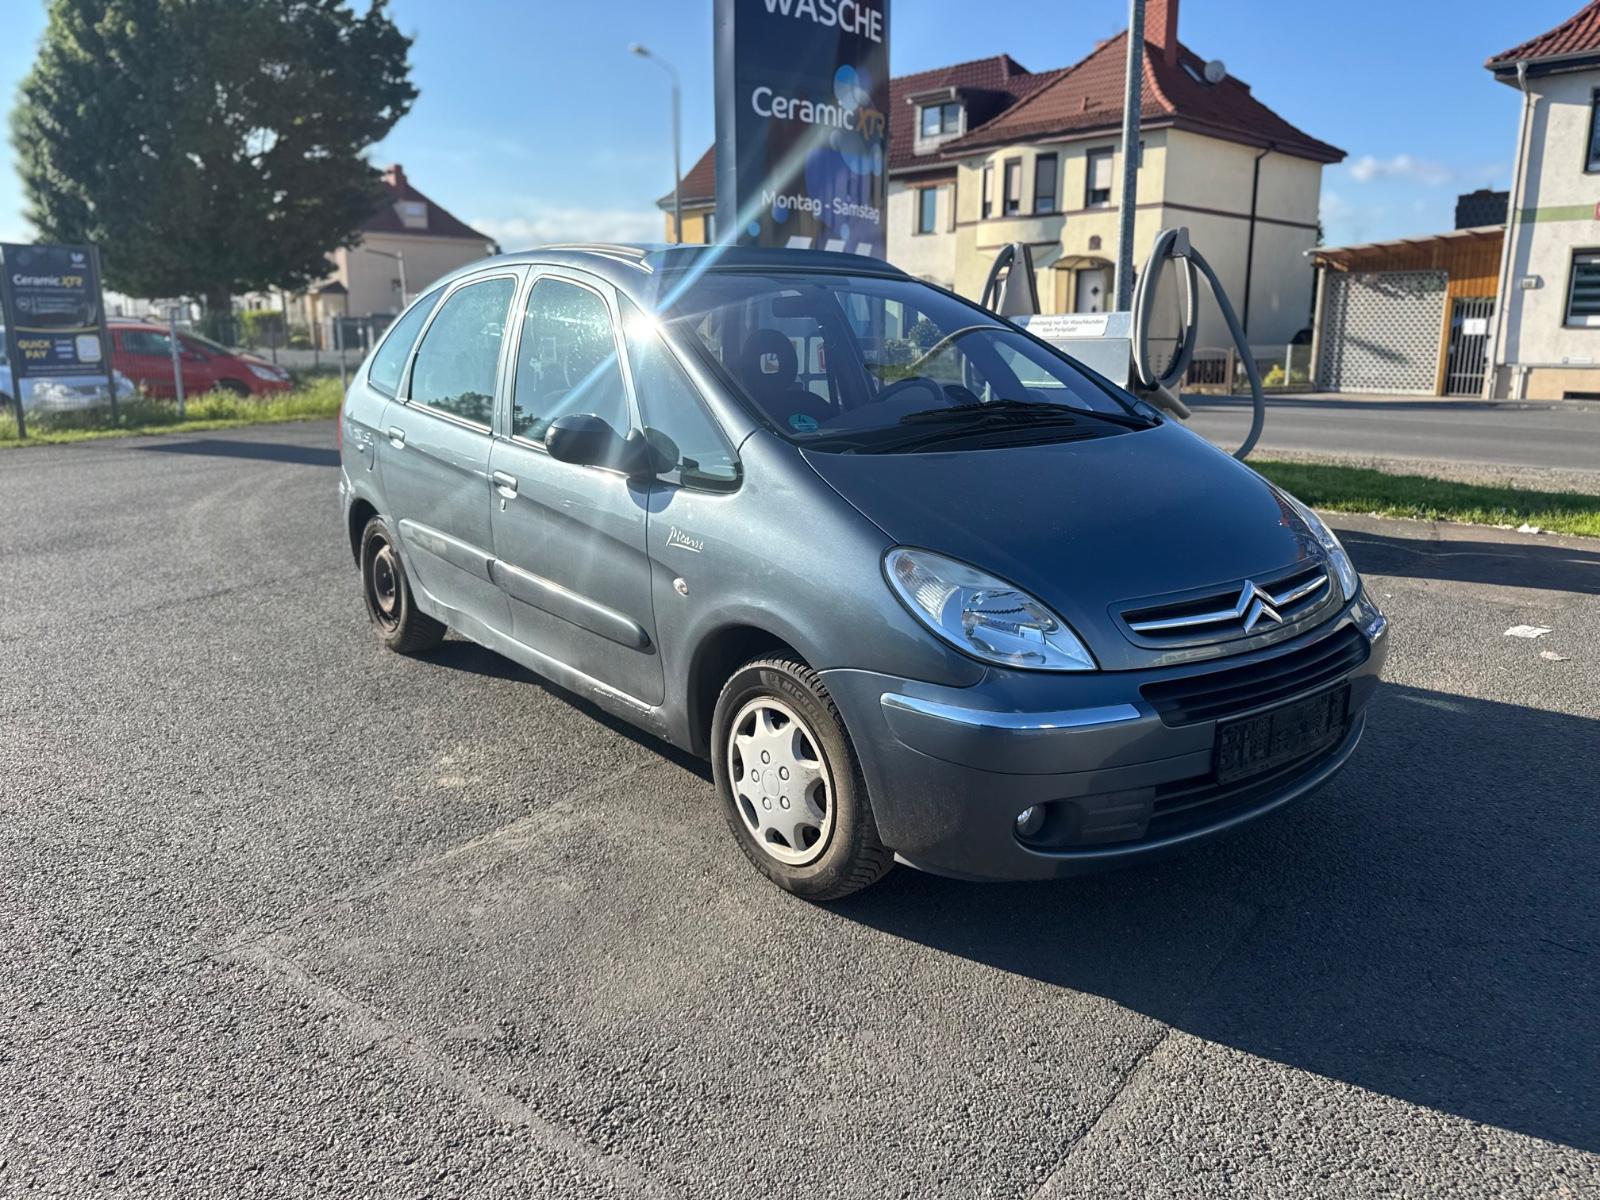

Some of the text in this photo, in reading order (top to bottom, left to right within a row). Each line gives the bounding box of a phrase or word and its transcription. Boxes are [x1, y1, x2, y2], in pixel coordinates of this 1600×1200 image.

[761, 189, 823, 216] Montag
[833, 197, 880, 225] Samstag
[25, 350, 47, 359] PAY
[666, 526, 704, 550] Picasso
